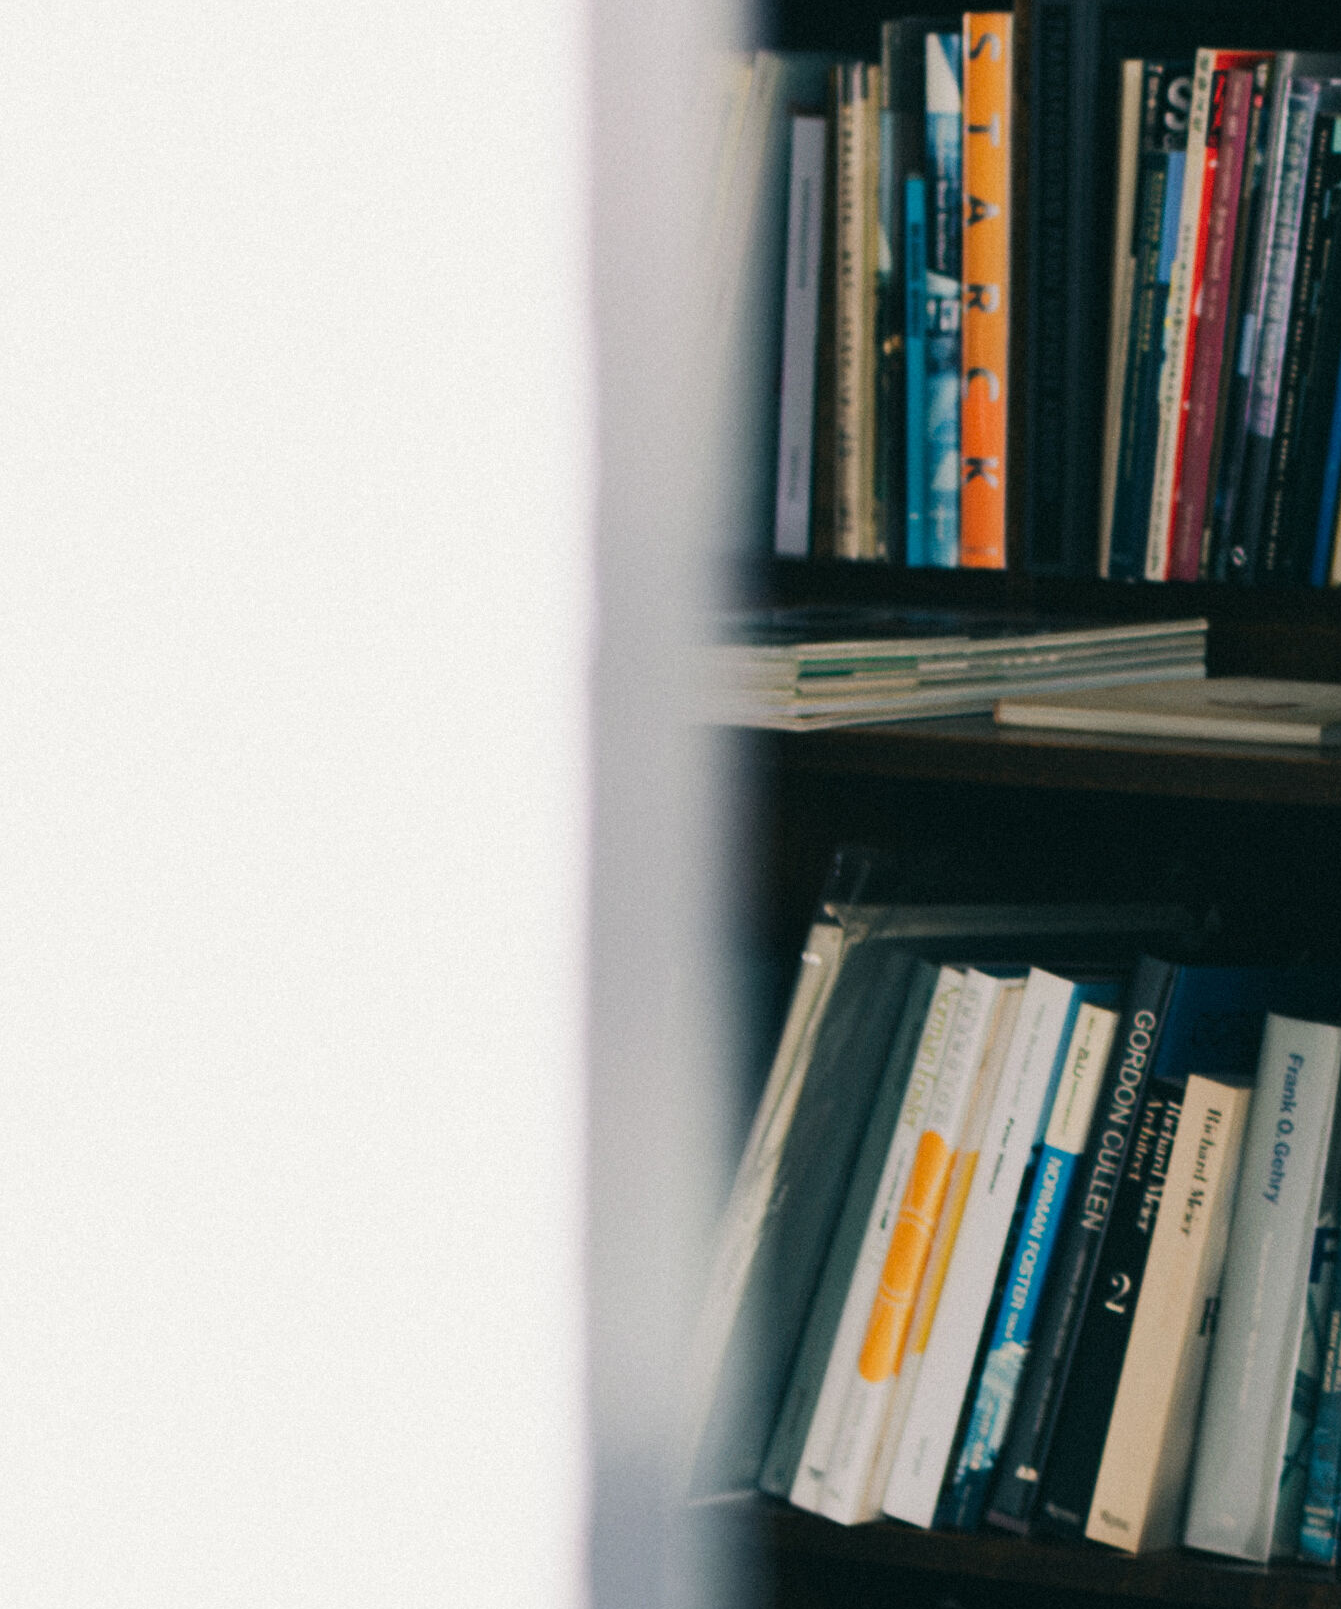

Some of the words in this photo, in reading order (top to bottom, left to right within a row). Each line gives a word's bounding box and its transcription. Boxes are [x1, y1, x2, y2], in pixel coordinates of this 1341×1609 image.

[966, 32, 1001, 488] STARCK
[1108, 1008, 1157, 1125] GORDON
[1279, 1053, 1305, 1114] Frank
[1192, 1108, 1222, 1182] Richard
[1275, 1117, 1295, 1139] O.
[1028, 1156, 1063, 1238] NORMAN
[1079, 1128, 1125, 1233] CULLEN
[1261, 1140, 1290, 1205] Gehry
[1180, 1187, 1205, 1237] Meier
[1010, 1239, 1041, 1310] FOSTER
[1106, 1274, 1131, 1314] 2
